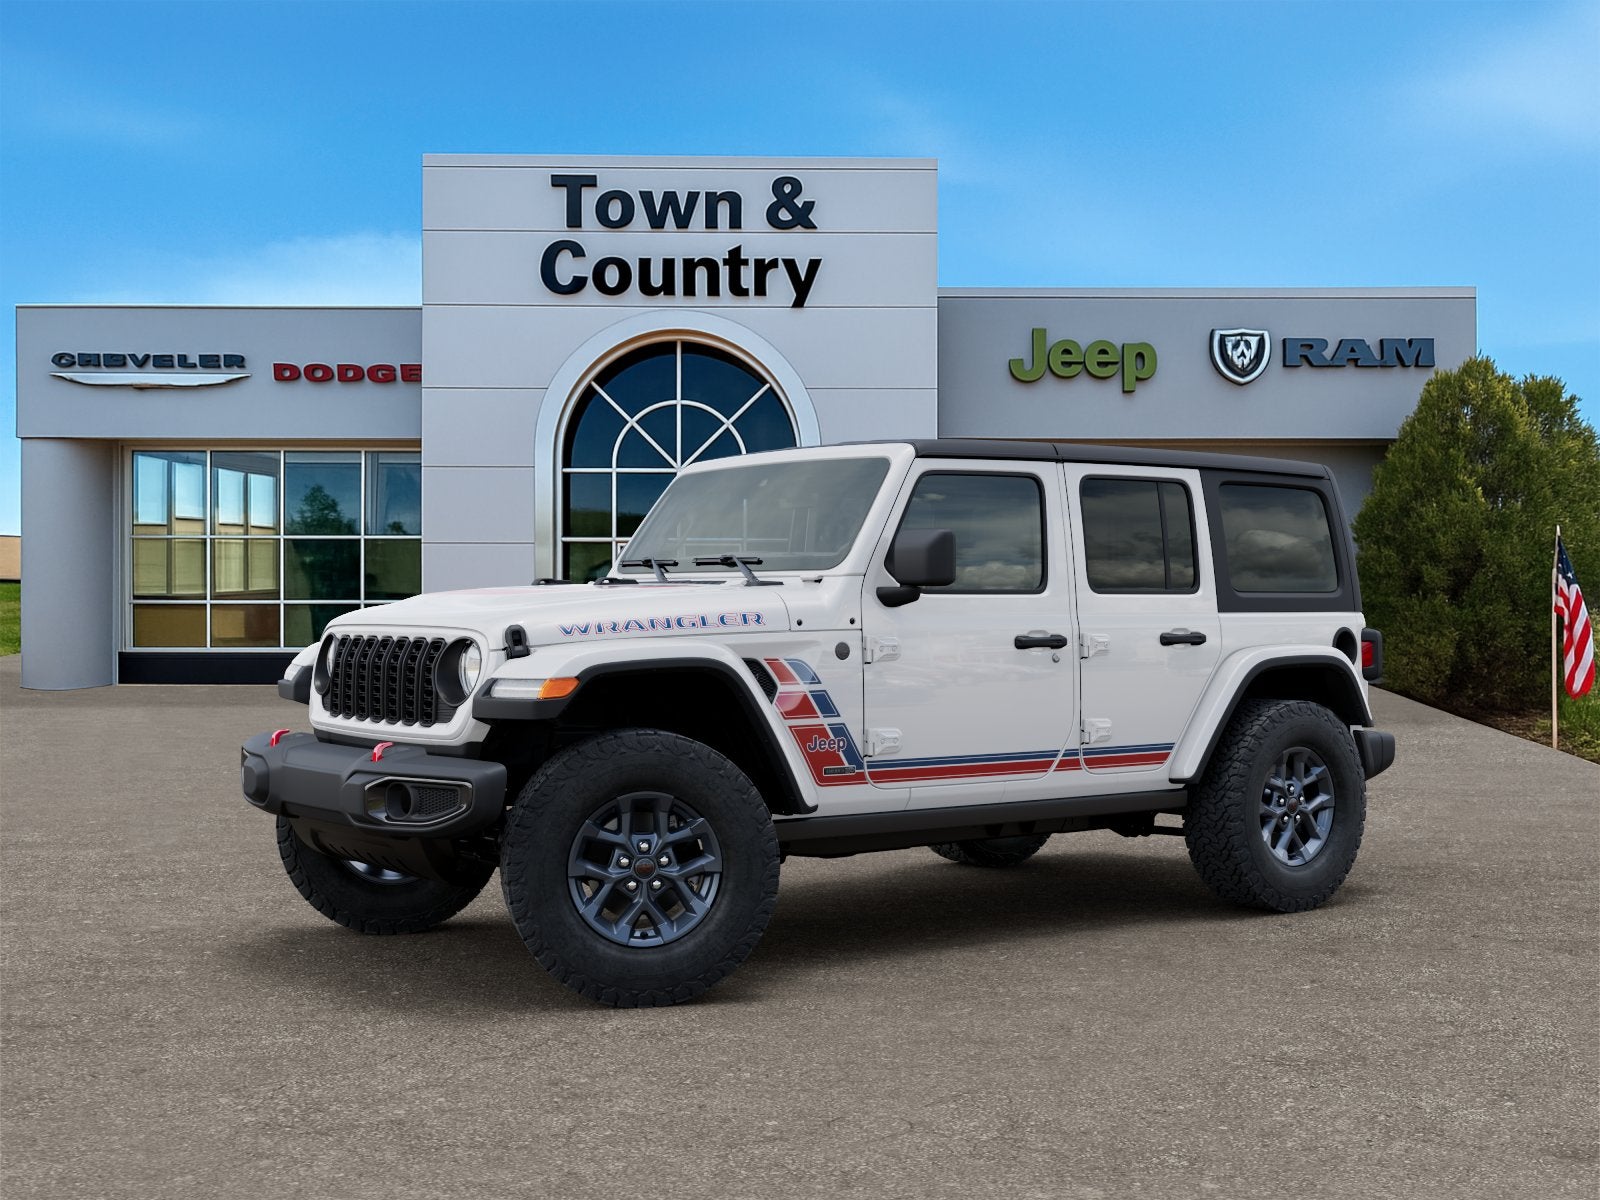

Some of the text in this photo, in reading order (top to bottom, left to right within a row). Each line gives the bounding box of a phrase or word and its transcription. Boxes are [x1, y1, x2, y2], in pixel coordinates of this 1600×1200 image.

[550, 174, 818, 230] Town &
[540, 239, 822, 308] Country
[1008, 327, 1158, 393] Jeep
[1282, 337, 1436, 368] RAM
[273, 362, 422, 383] DODGE
[557, 611, 767, 637] WRANGLER
[807, 734, 847, 754] Jeep
